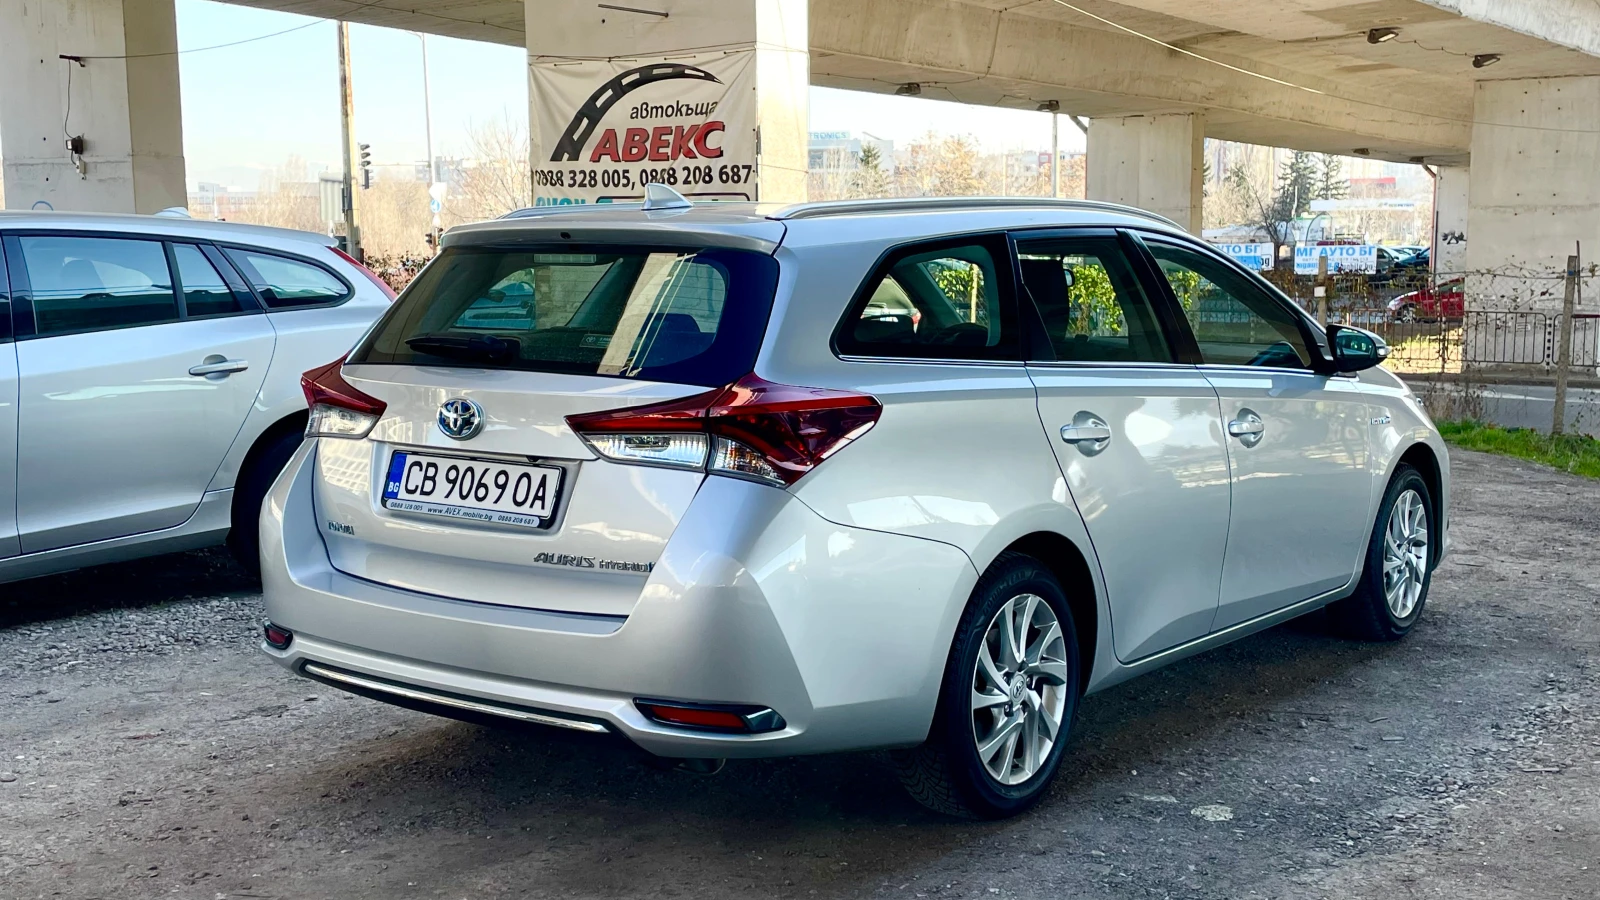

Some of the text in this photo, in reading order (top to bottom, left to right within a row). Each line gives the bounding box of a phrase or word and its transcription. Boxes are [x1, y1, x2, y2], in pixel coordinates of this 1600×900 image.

[629, 100, 718, 120] автокъща
[589, 121, 725, 163] АВЕКС
[568, 169, 598, 188] 328
[601, 169, 635, 191] 005,
[682, 165, 713, 185] 208
[718, 164, 752, 184] 687
[1296, 246, 1376, 257] МГ АУТО БГ
[388, 460, 548, 511] BG CB 9069 OA
[533, 551, 596, 569] AURIS
